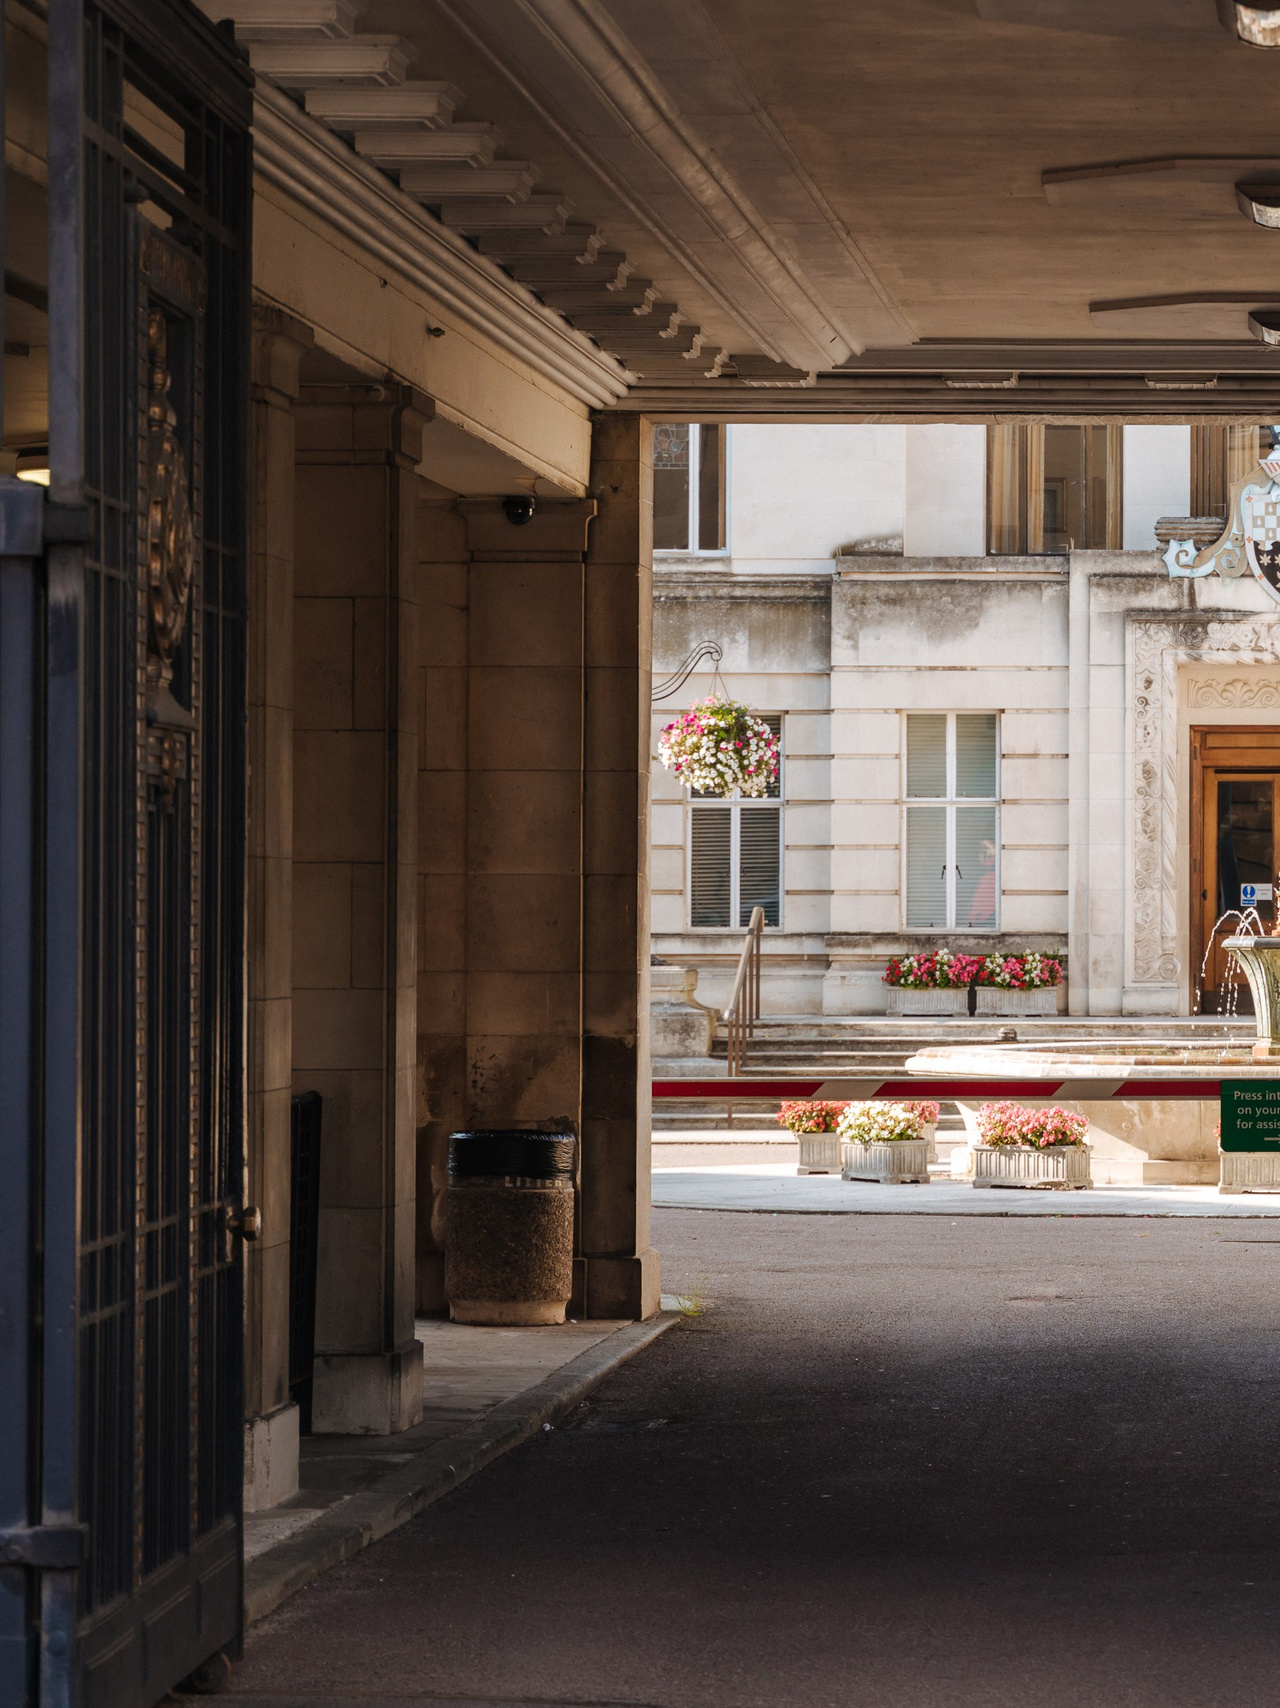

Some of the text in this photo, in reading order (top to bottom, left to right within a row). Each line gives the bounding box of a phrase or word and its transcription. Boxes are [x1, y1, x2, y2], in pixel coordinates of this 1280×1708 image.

[1234, 1091, 1262, 1100] Press
[1237, 1106, 1252, 1115] on
[1236, 1119, 1253, 1129] for
